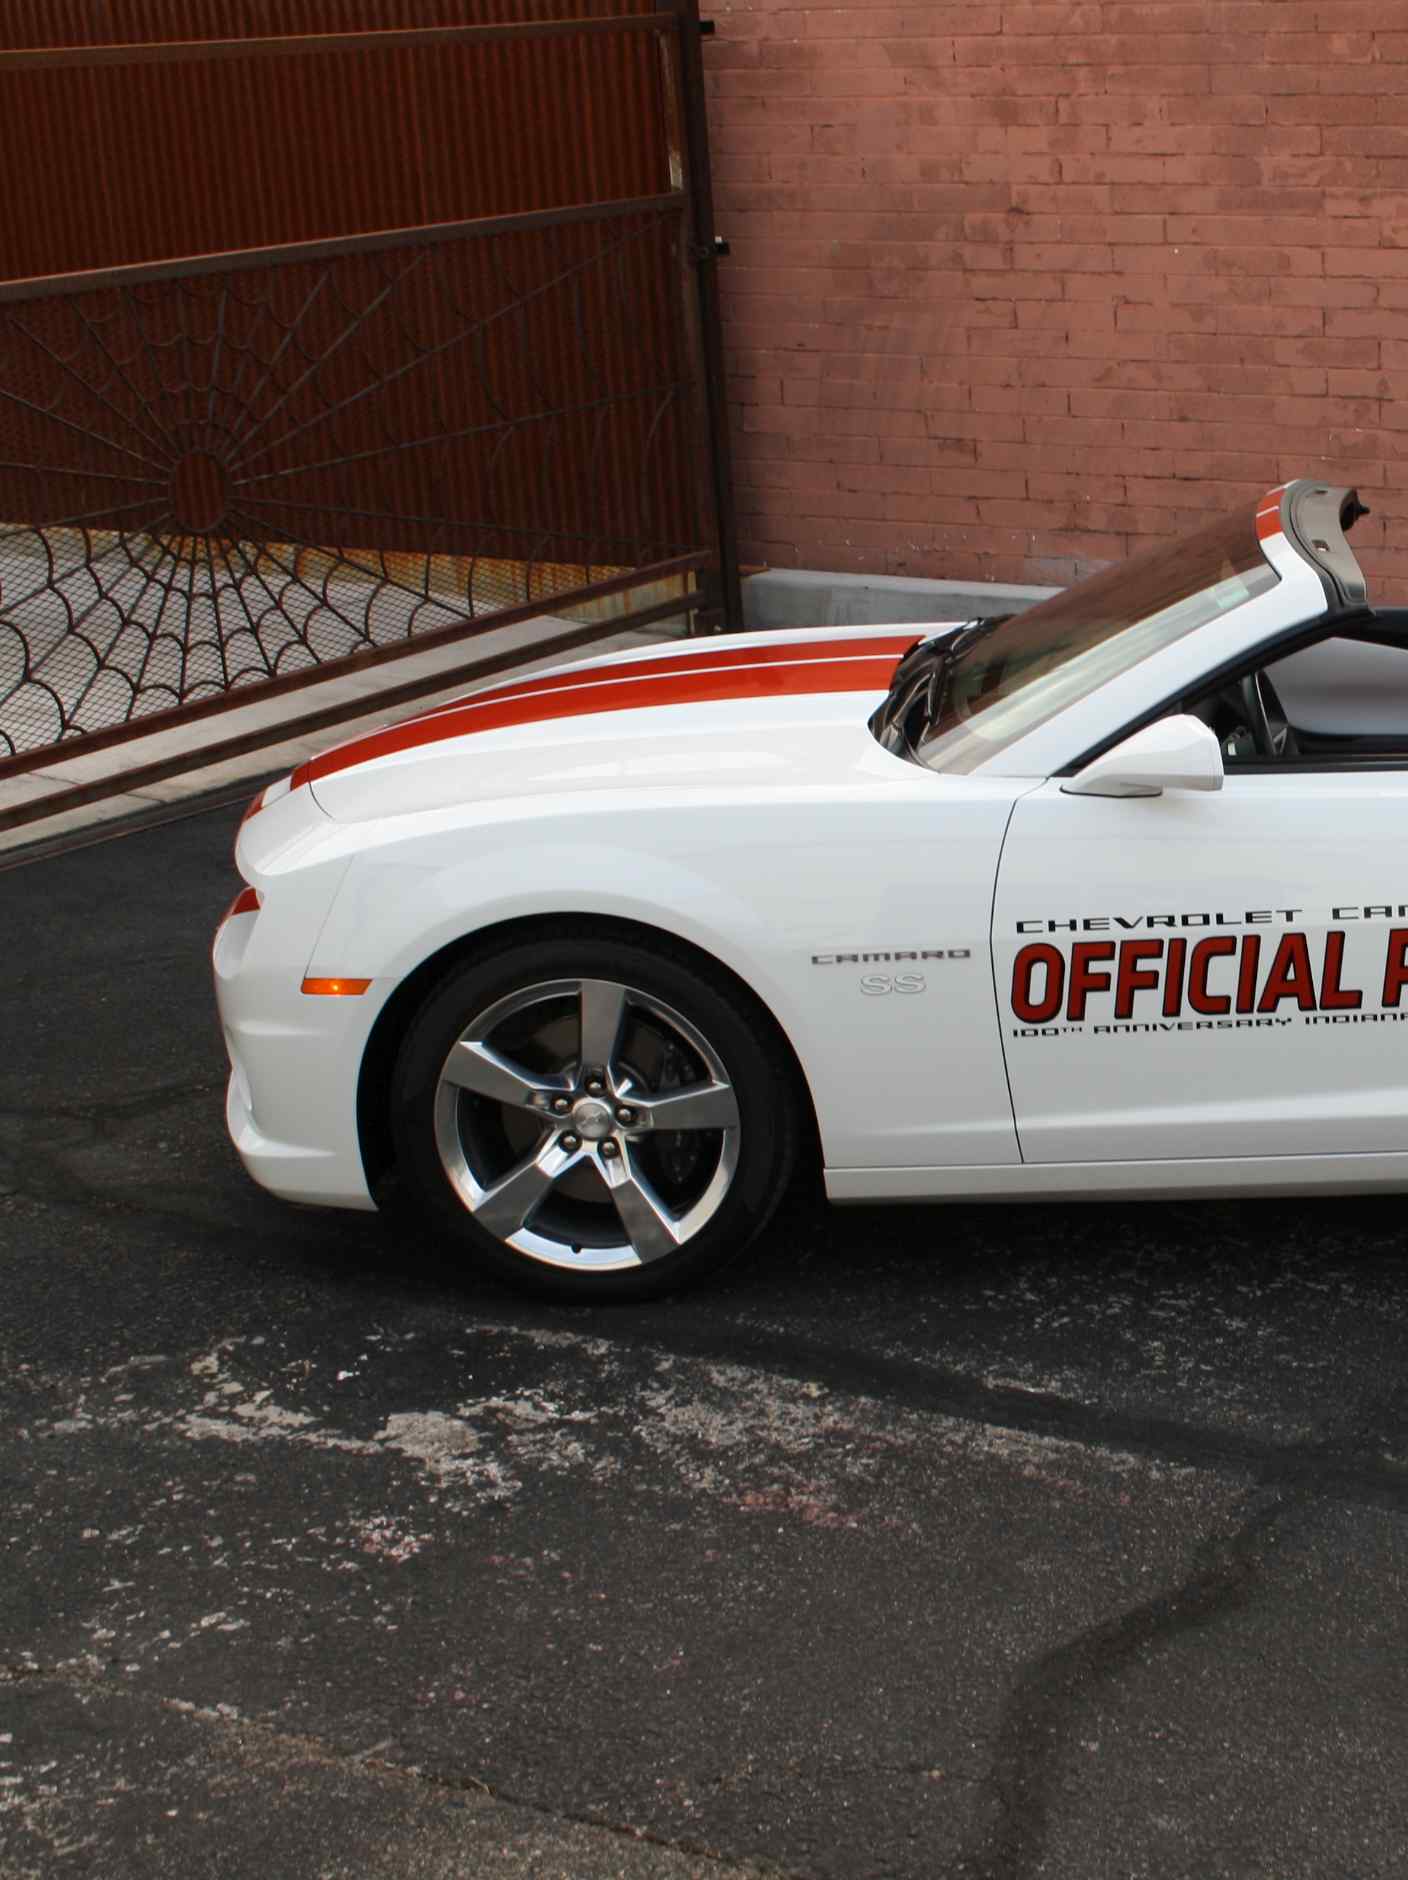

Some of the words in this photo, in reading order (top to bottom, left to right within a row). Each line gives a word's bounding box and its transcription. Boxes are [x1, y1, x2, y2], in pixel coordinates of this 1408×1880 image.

[1015, 908, 1303, 934] CHEVROLET
[811, 948, 971, 965] CAMARO
[860, 973, 927, 996] SS
[1010, 930, 1363, 1025] OFFICIAL
[1093, 1017, 1292, 1034] ANNIVERSARY
